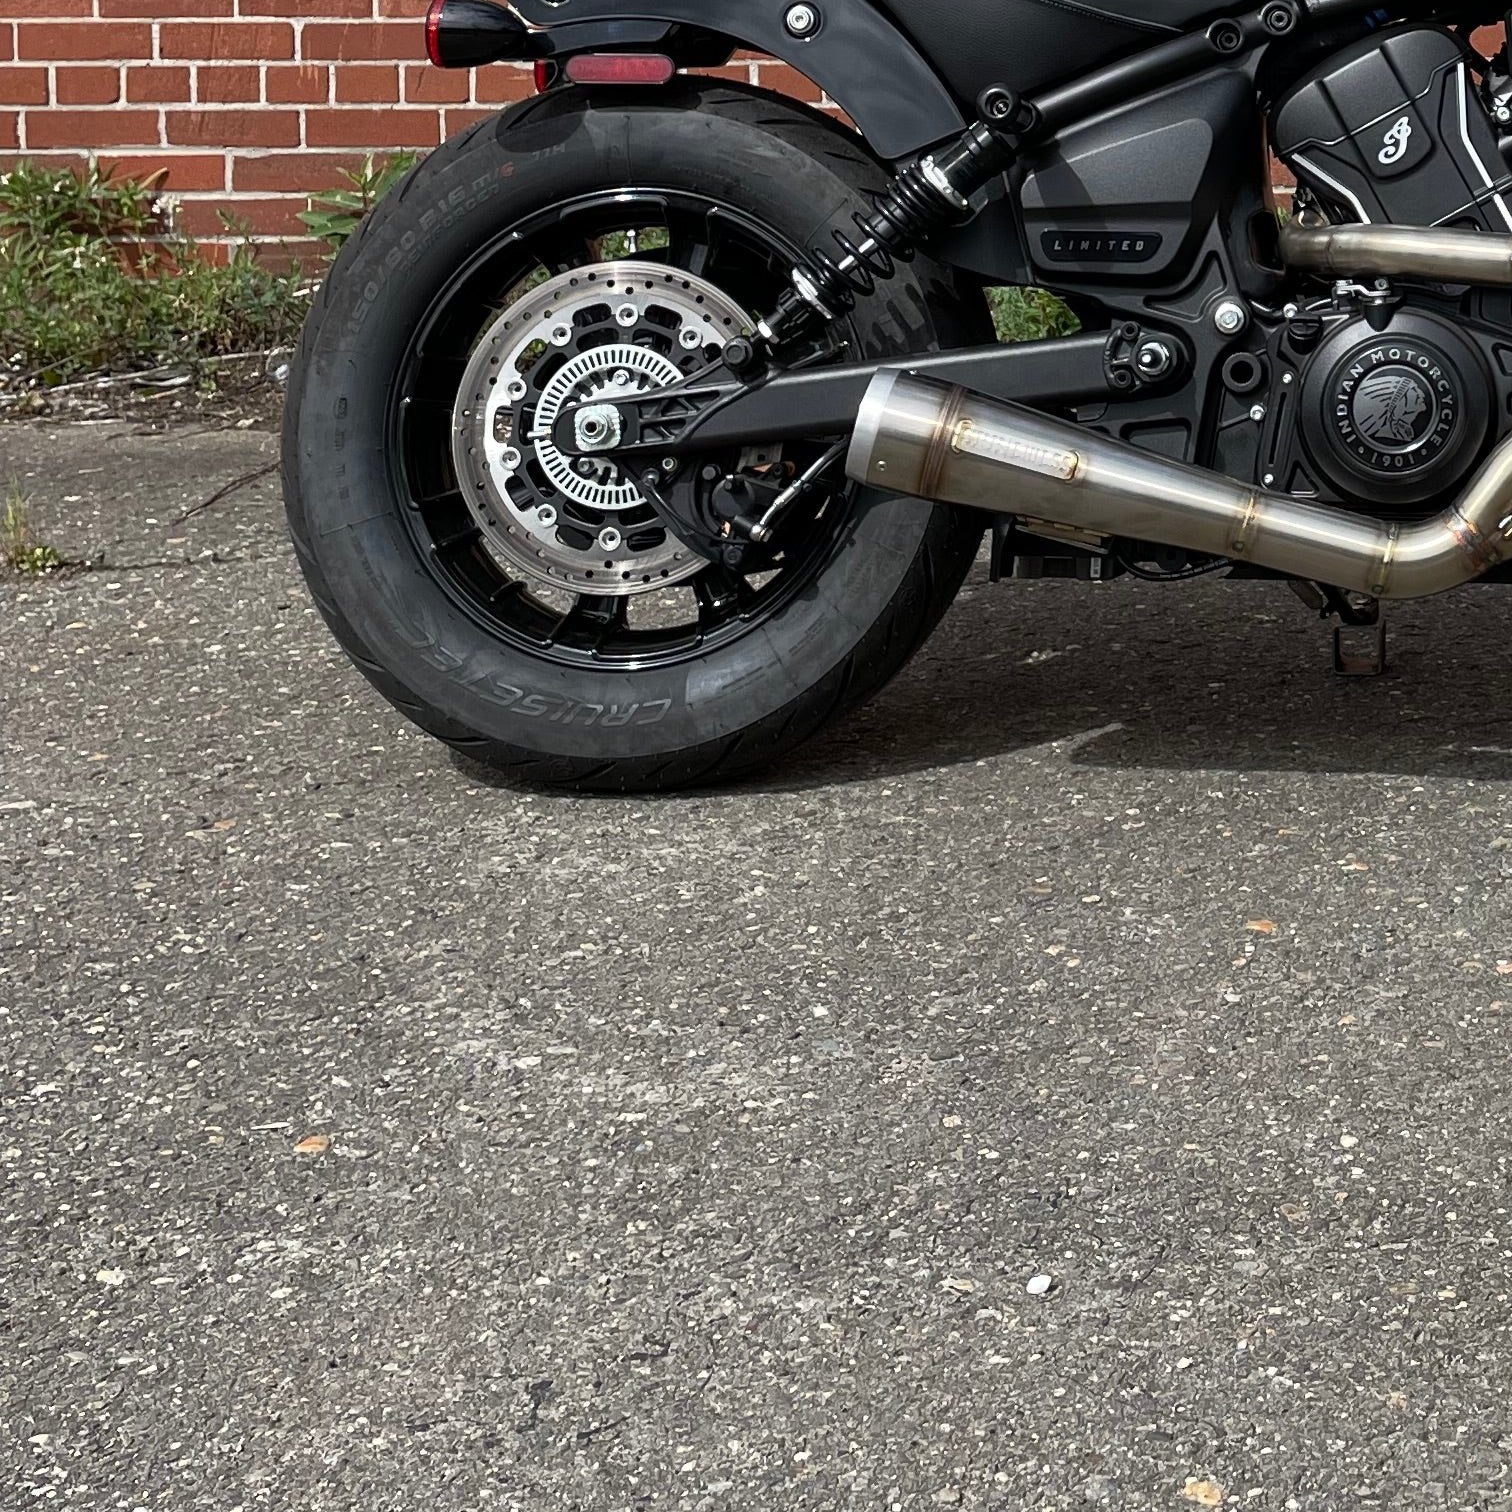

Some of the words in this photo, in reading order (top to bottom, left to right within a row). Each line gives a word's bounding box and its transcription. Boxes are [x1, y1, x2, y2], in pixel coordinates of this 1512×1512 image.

[1053, 239, 1145, 251] LIMITED
[1336, 363, 1365, 444] INDIAN
[1370, 348, 1454, 447] MOTORCYCLE
[1370, 452, 1416, 468] 1901
[394, 622, 672, 729] CRUISETEC
